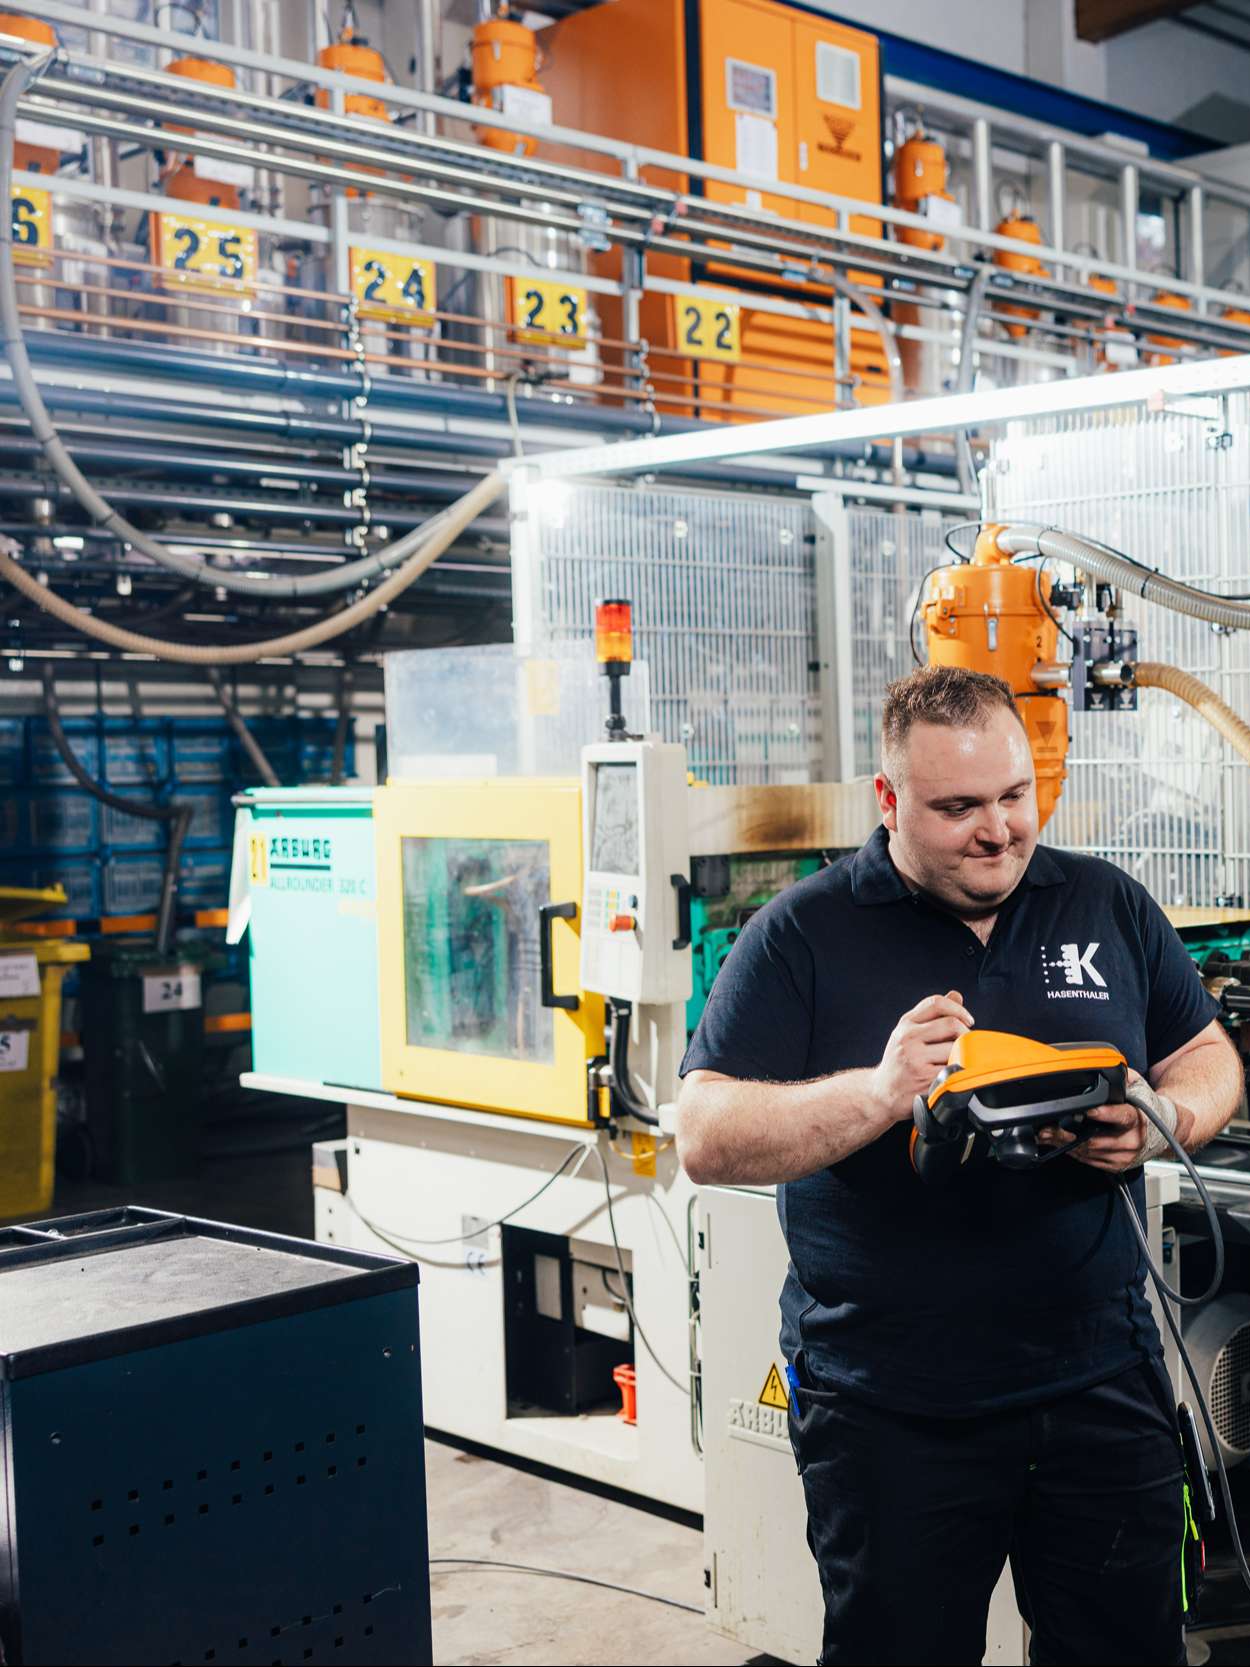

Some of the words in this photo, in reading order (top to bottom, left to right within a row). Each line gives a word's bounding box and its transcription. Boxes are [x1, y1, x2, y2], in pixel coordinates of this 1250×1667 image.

[12, 197, 39, 246] 6
[174, 228, 244, 279] 25
[364, 260, 425, 310] 24
[525, 290, 579, 335] 23
[685, 306, 732, 350] 22
[270, 837, 332, 860] ARBURG
[161, 981, 183, 1000] 24
[1047, 990, 1109, 1000] HASENTHALER
[731, 1402, 789, 1439] ARBU
